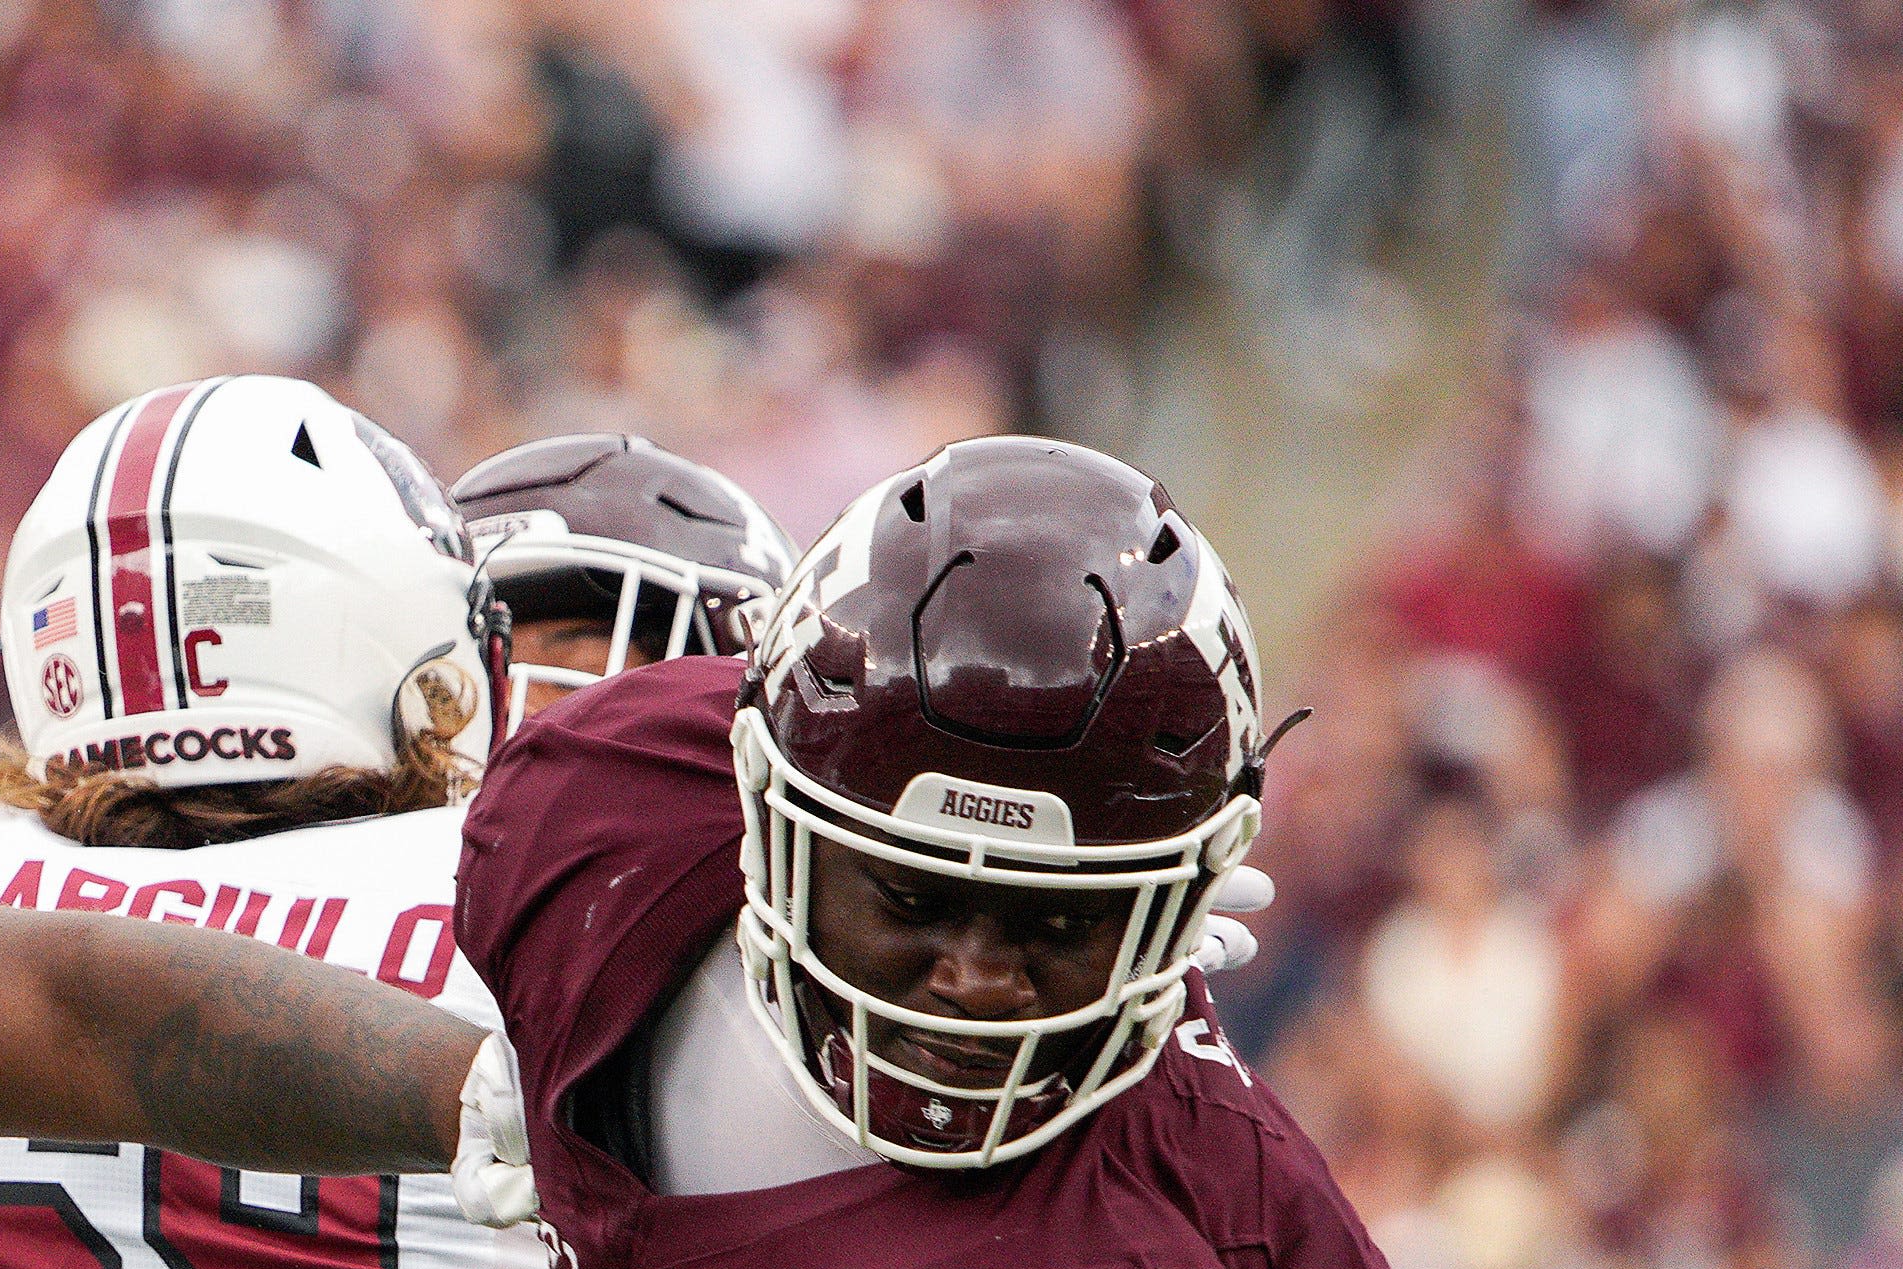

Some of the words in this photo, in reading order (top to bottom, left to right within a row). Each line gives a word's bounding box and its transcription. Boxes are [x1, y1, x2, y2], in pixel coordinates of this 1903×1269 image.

[42, 656, 82, 716] SEC
[184, 628, 230, 697] C
[939, 787, 1037, 830] AGGIES
